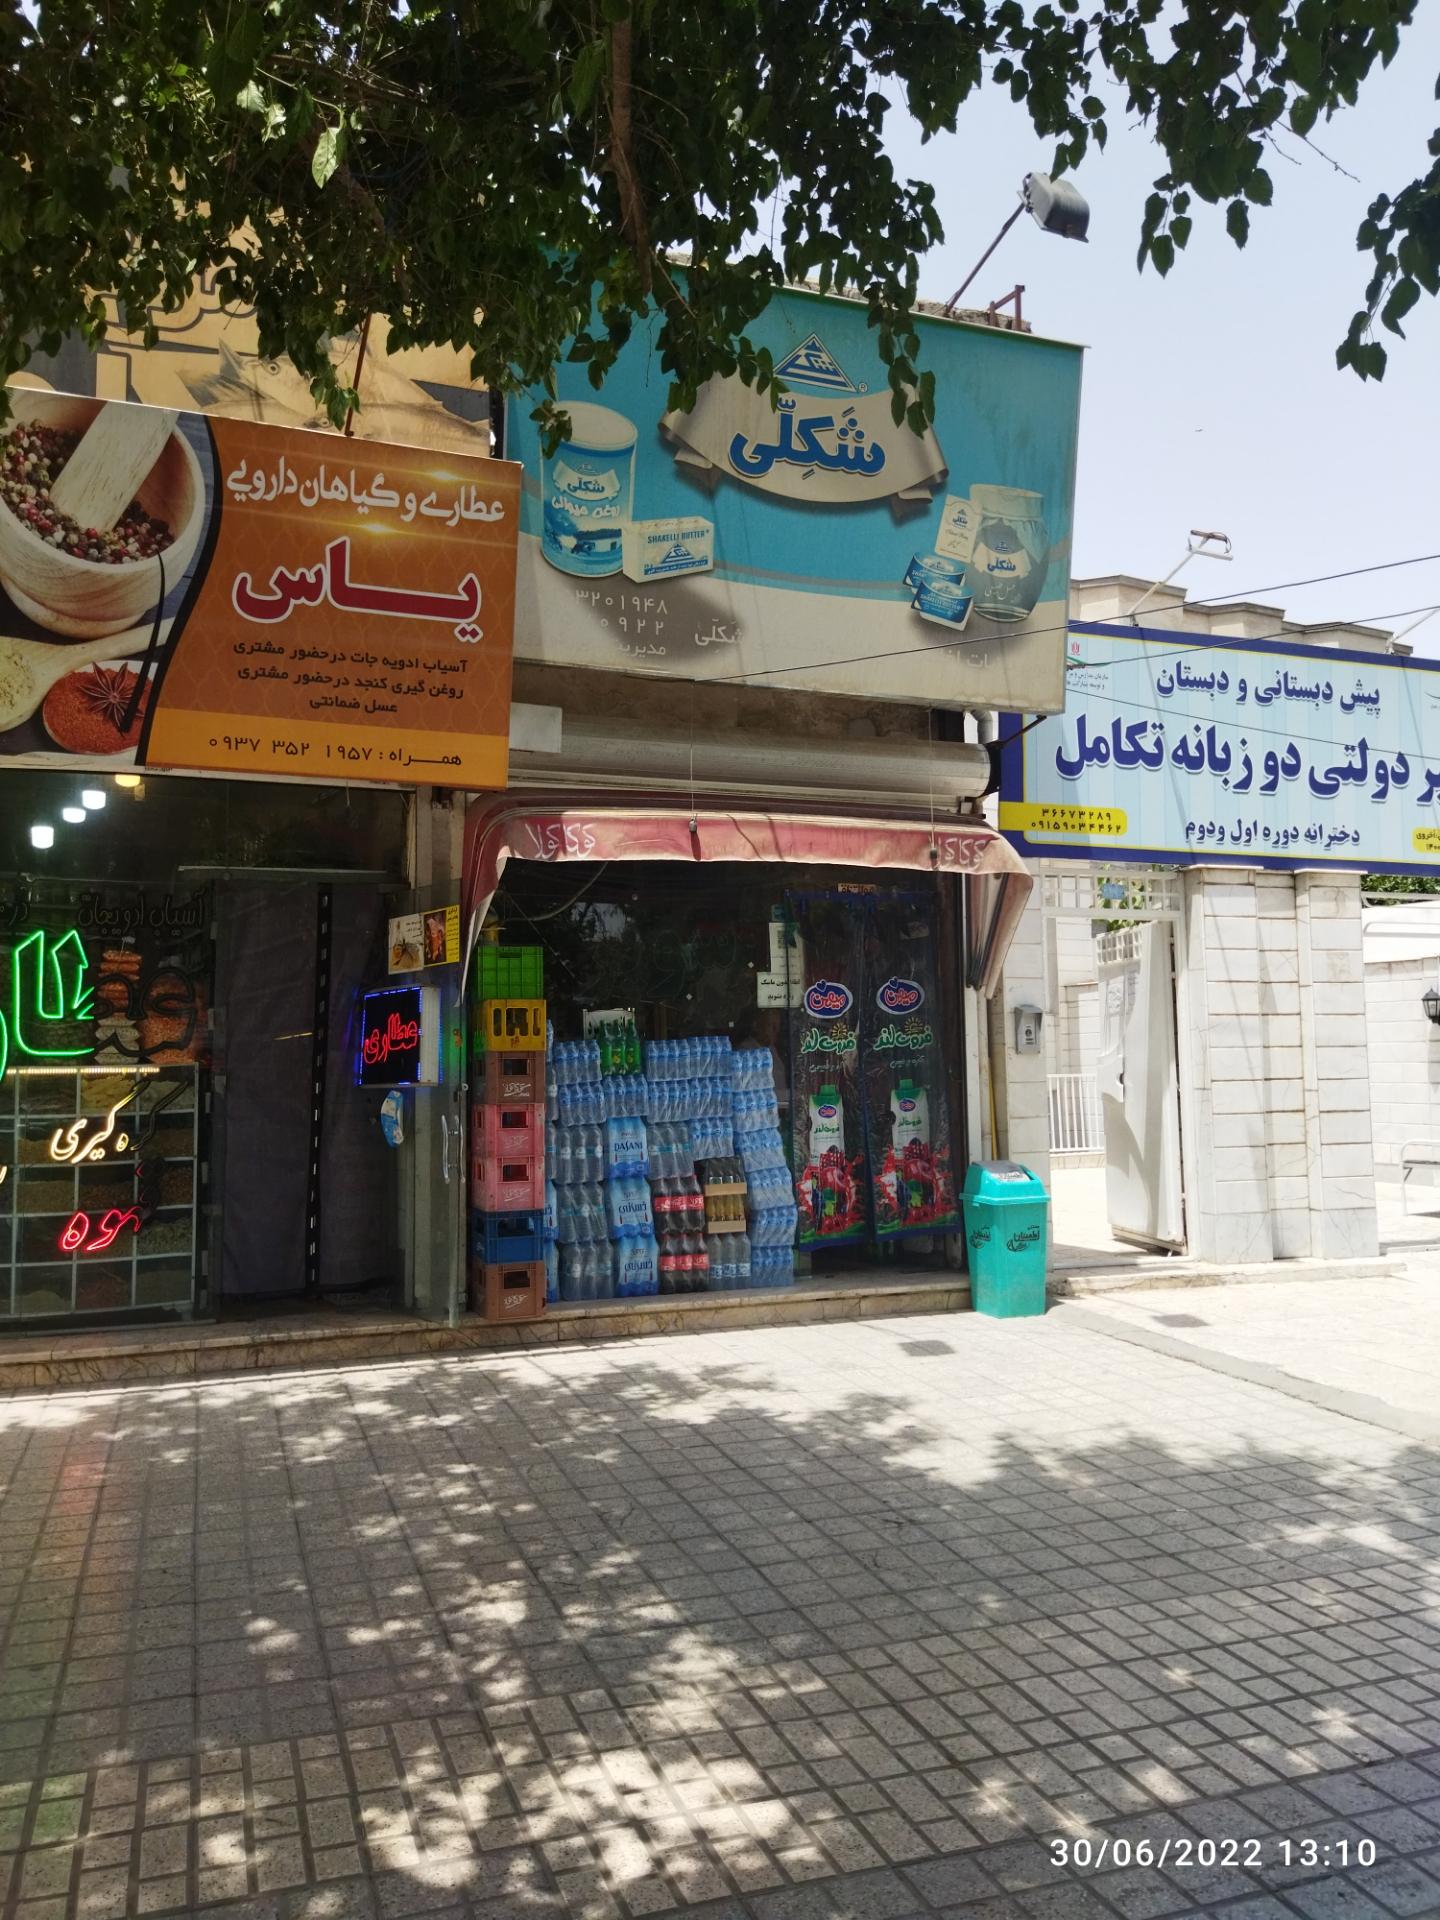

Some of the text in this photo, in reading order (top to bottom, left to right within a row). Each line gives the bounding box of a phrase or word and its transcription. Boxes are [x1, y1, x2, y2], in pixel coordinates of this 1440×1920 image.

[299, 464, 401, 515] گیاهان
[232, 535, 483, 643] یاس
[233, 641, 286, 656] مشتری
[350, 651, 379, 667] جات
[381, 656, 419, 671] ادویه
[423, 658, 468, 674] آسیاب
[237, 665, 290, 680] مشتری
[354, 676, 388, 692] کنجد
[391, 679, 426, 696] گیری
[428, 683, 465, 699] روغن
[1156, 659, 1381, 716] پیش دبستانی و دبستان
[308, 694, 398, 714] عسل ضمانتی
[1055, 712, 1165, 780] تکامل
[1170, 723, 1254, 794] زبانه
[1260, 741, 1302, 795] دو
[1230, 818, 1258, 846] اول
[1262, 824, 1300, 849] دوره
[1303, 823, 1361, 850] دخترانه
[809, 990, 847, 1010] میهن
[884, 987, 919, 1006] میهن
[363, 1012, 418, 1064] عطاری
[614, 1140, 643, 1152] DASANI
